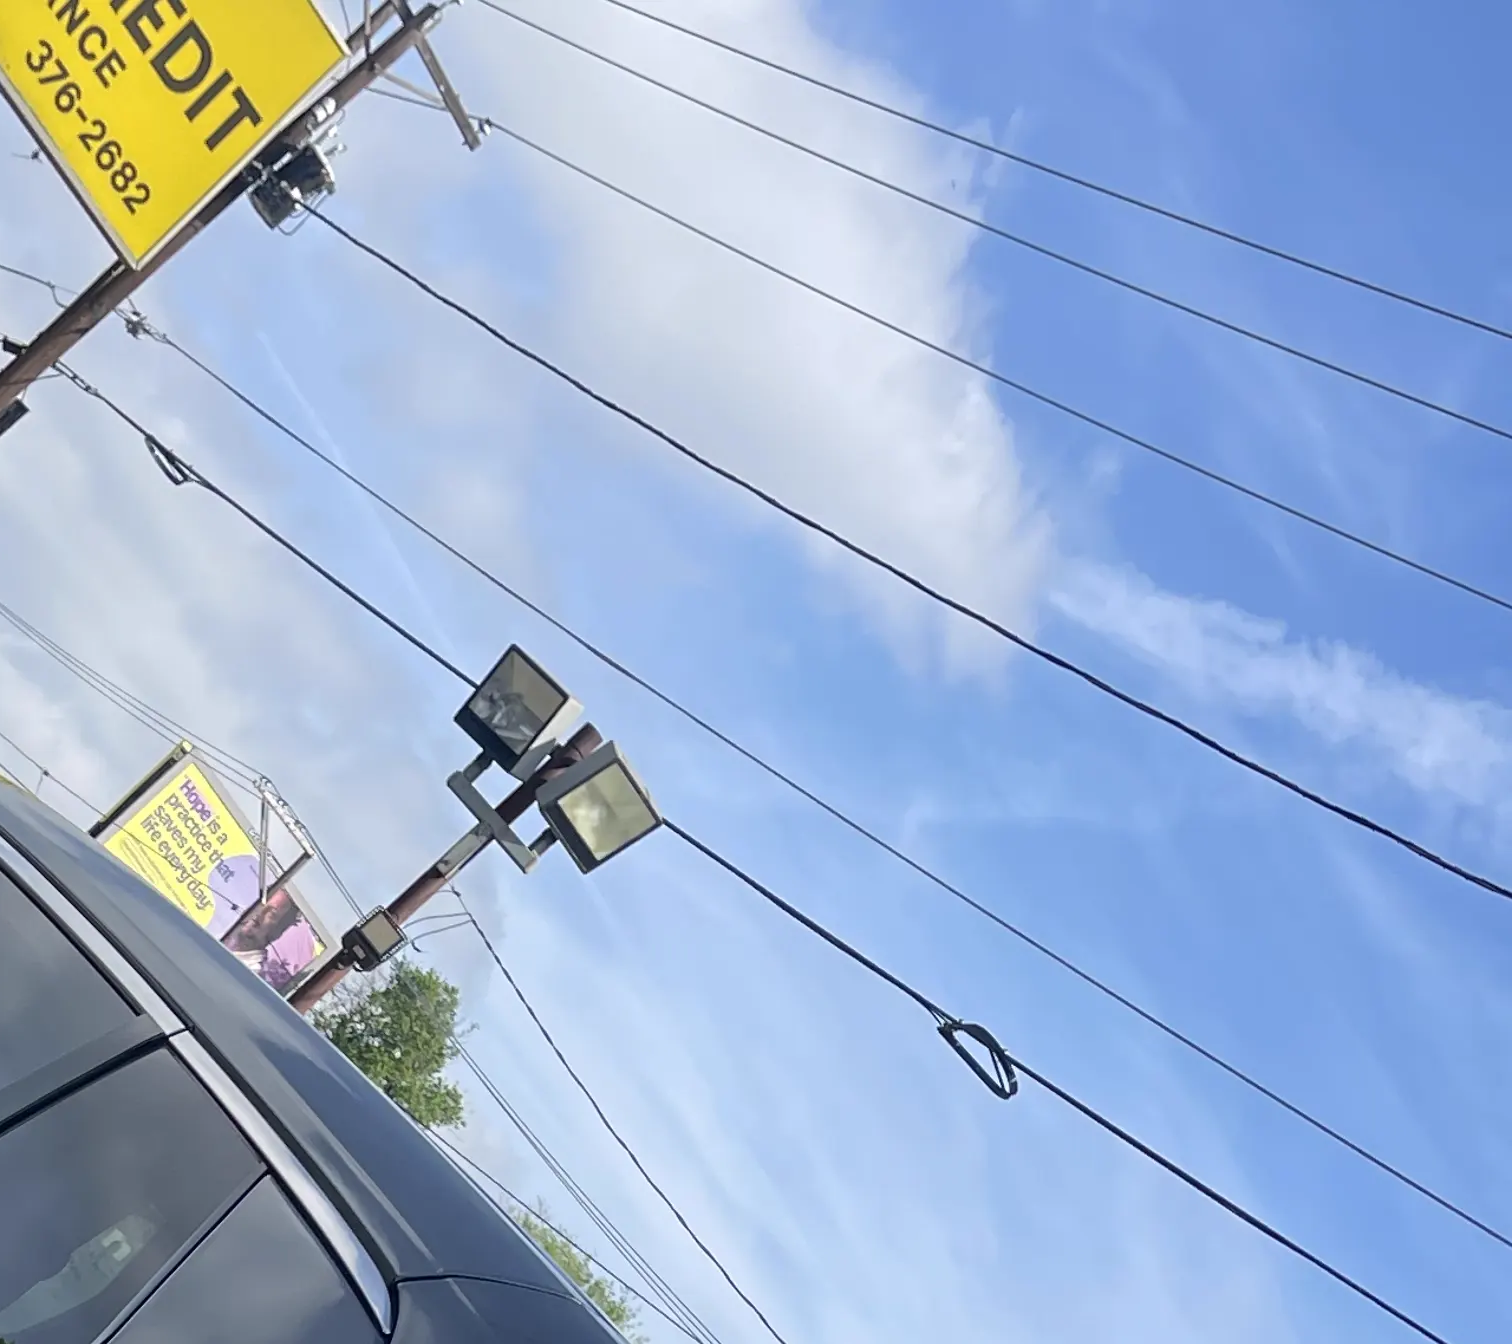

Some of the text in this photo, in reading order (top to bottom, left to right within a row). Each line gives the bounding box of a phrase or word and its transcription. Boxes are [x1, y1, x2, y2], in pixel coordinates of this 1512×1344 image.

[47, 0, 127, 89] NCE
[110, 0, 263, 152] EDIT
[26, 39, 151, 215] 376-2682
[140, 814, 162, 843] life
[158, 841, 189, 883] every
[154, 805, 206, 875] saves my
[164, 793, 235, 884] practice that
[207, 815, 221, 835] is
[216, 832, 228, 846] a
